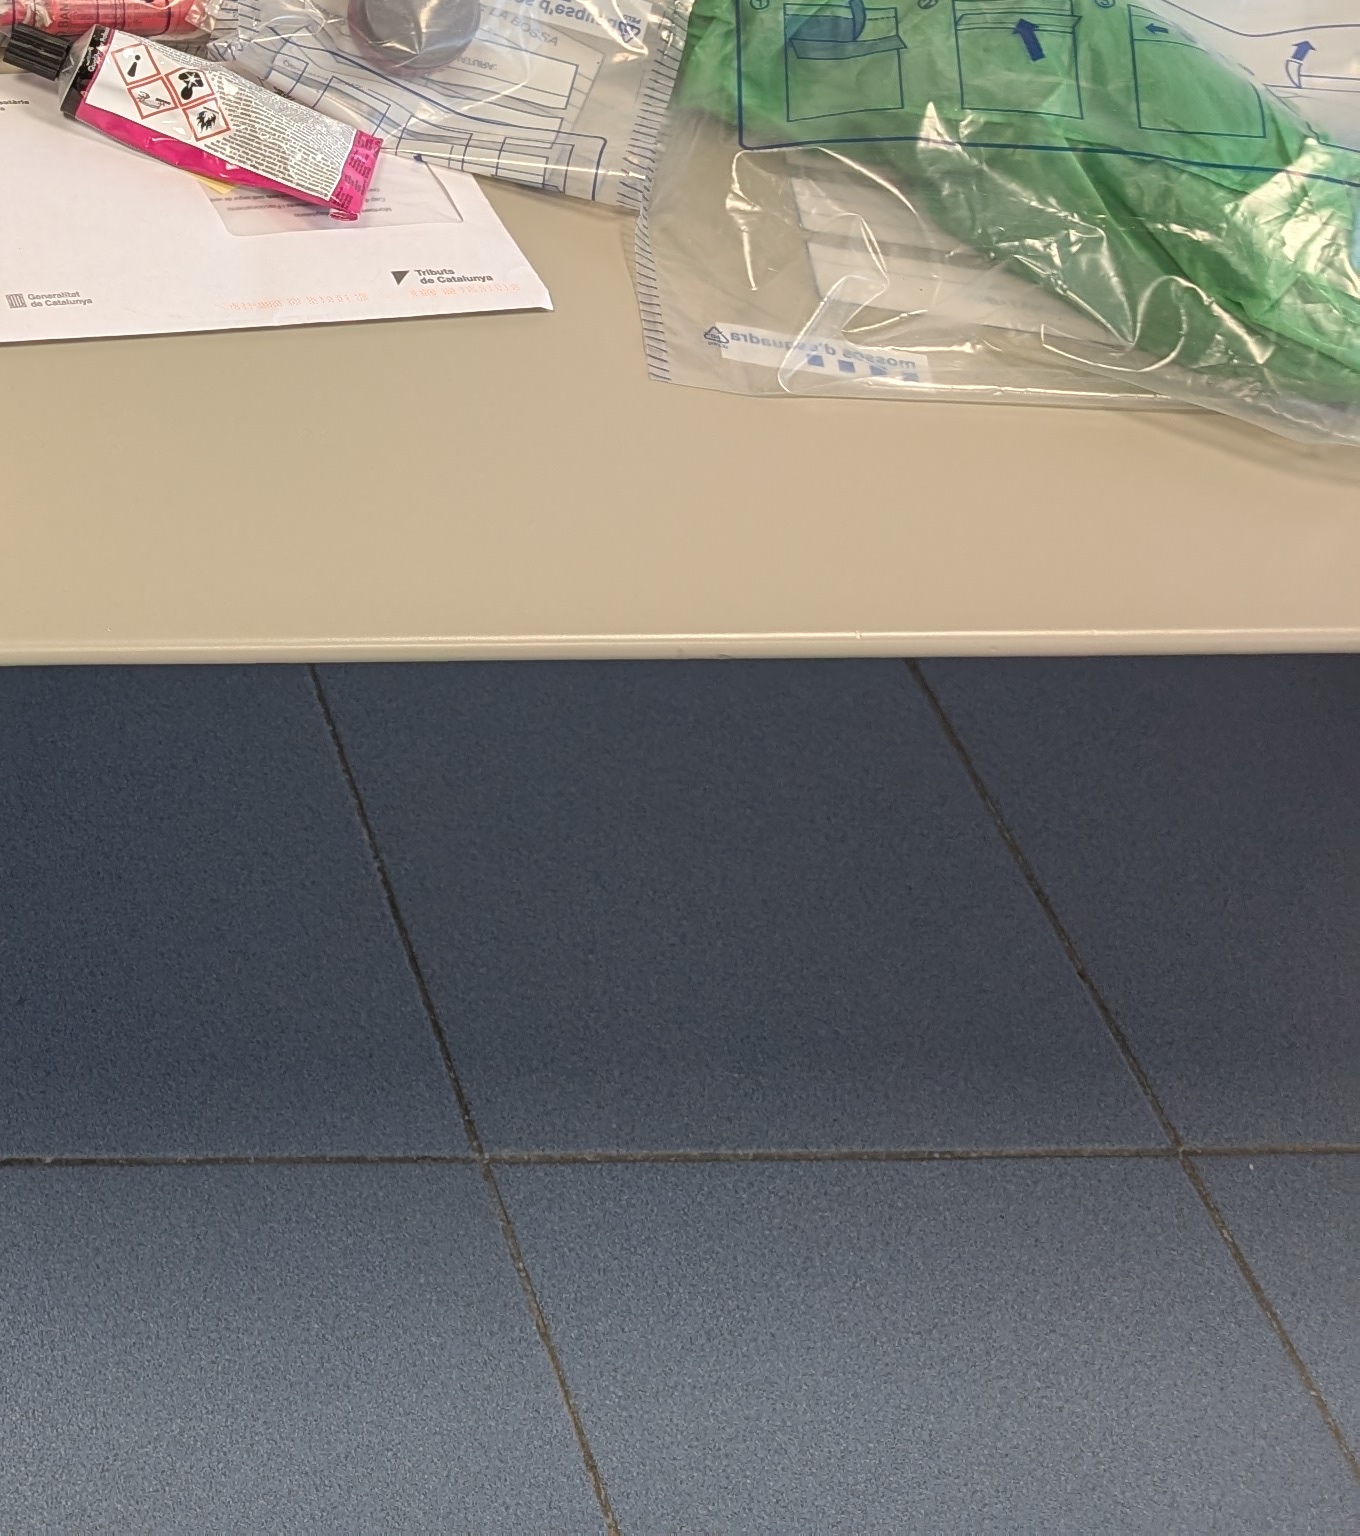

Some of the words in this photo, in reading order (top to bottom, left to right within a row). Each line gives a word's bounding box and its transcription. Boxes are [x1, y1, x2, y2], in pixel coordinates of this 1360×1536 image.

[414, 267, 455, 277] Tributs
[419, 277, 435, 285] de
[437, 273, 494, 284] Catalunya
